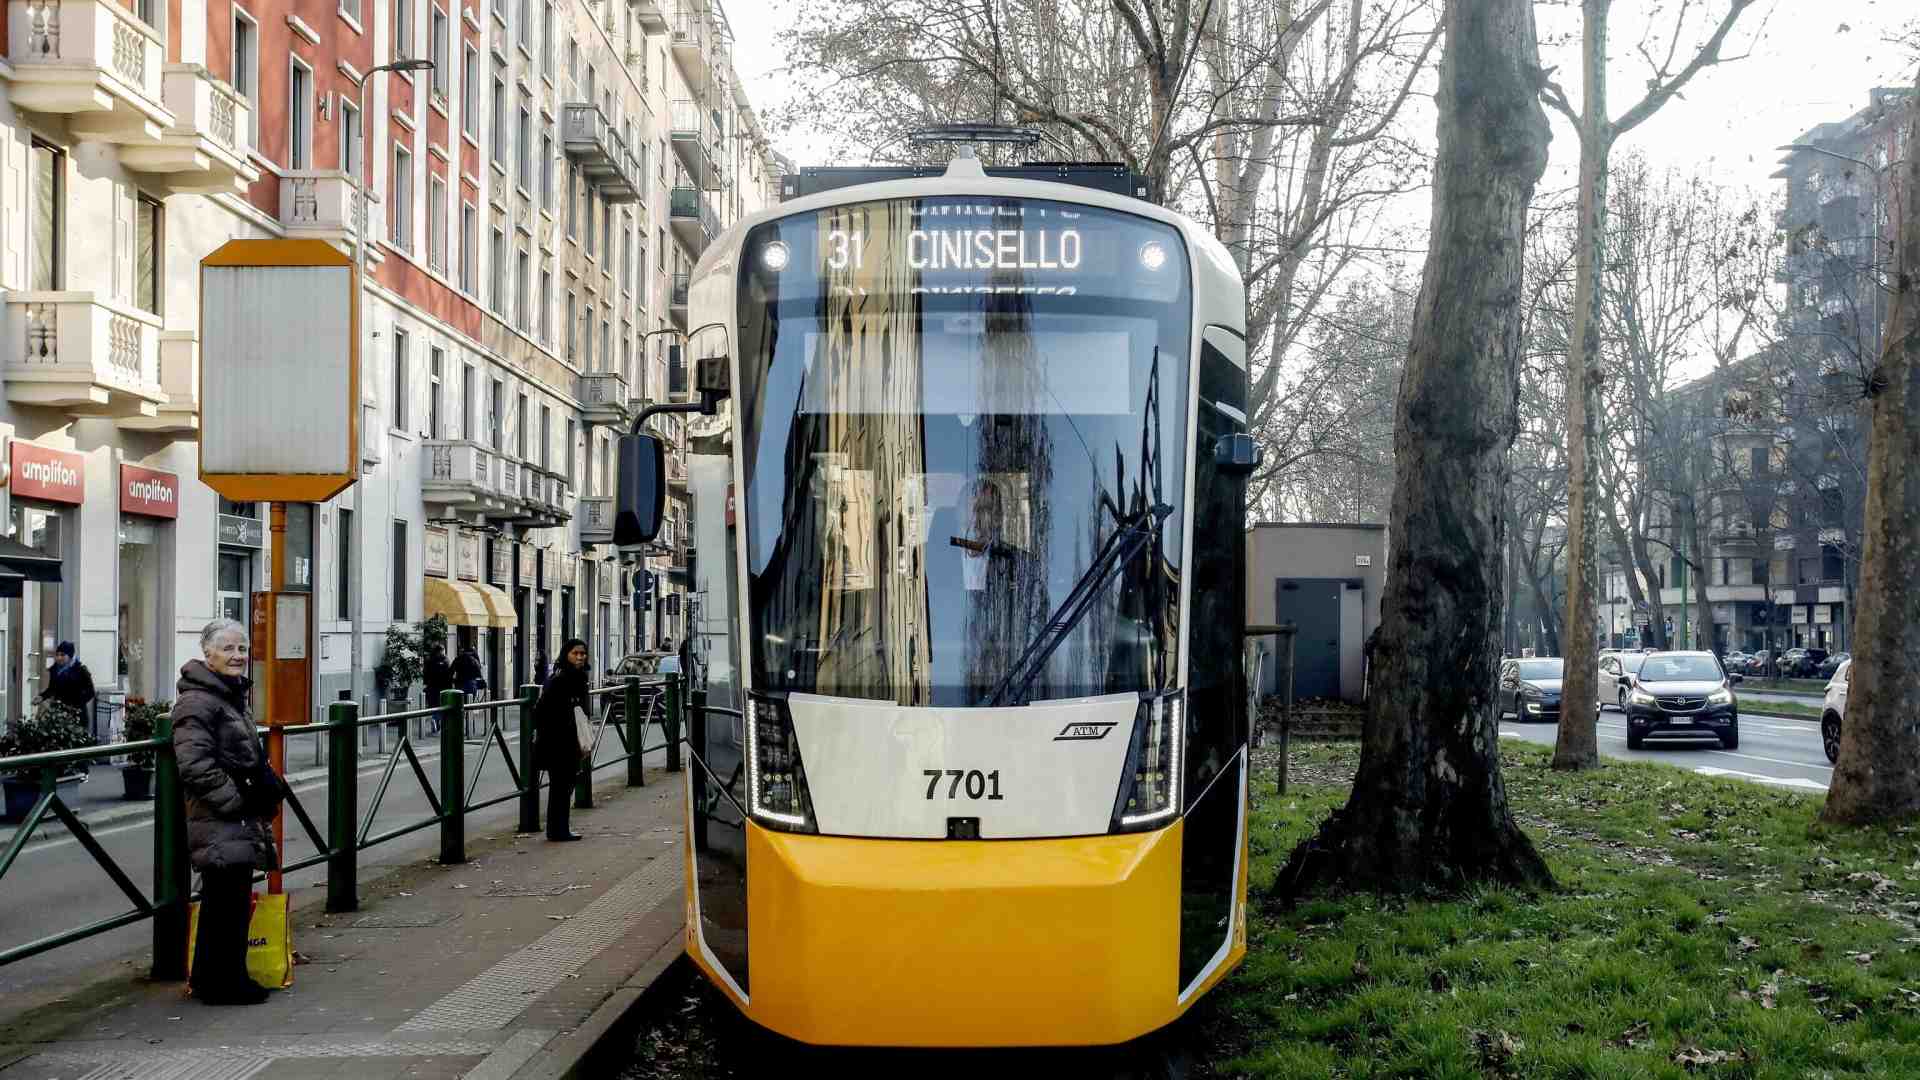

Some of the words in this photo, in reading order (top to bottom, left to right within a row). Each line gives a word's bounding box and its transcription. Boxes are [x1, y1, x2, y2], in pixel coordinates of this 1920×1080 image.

[828, 229, 865, 269] 31
[908, 229, 1082, 269] CINISELLO
[22, 460, 77, 488] amplifon
[129, 478, 173, 504] amplifon
[1073, 726, 1099, 736] ATM
[923, 769, 1004, 800] 7701
